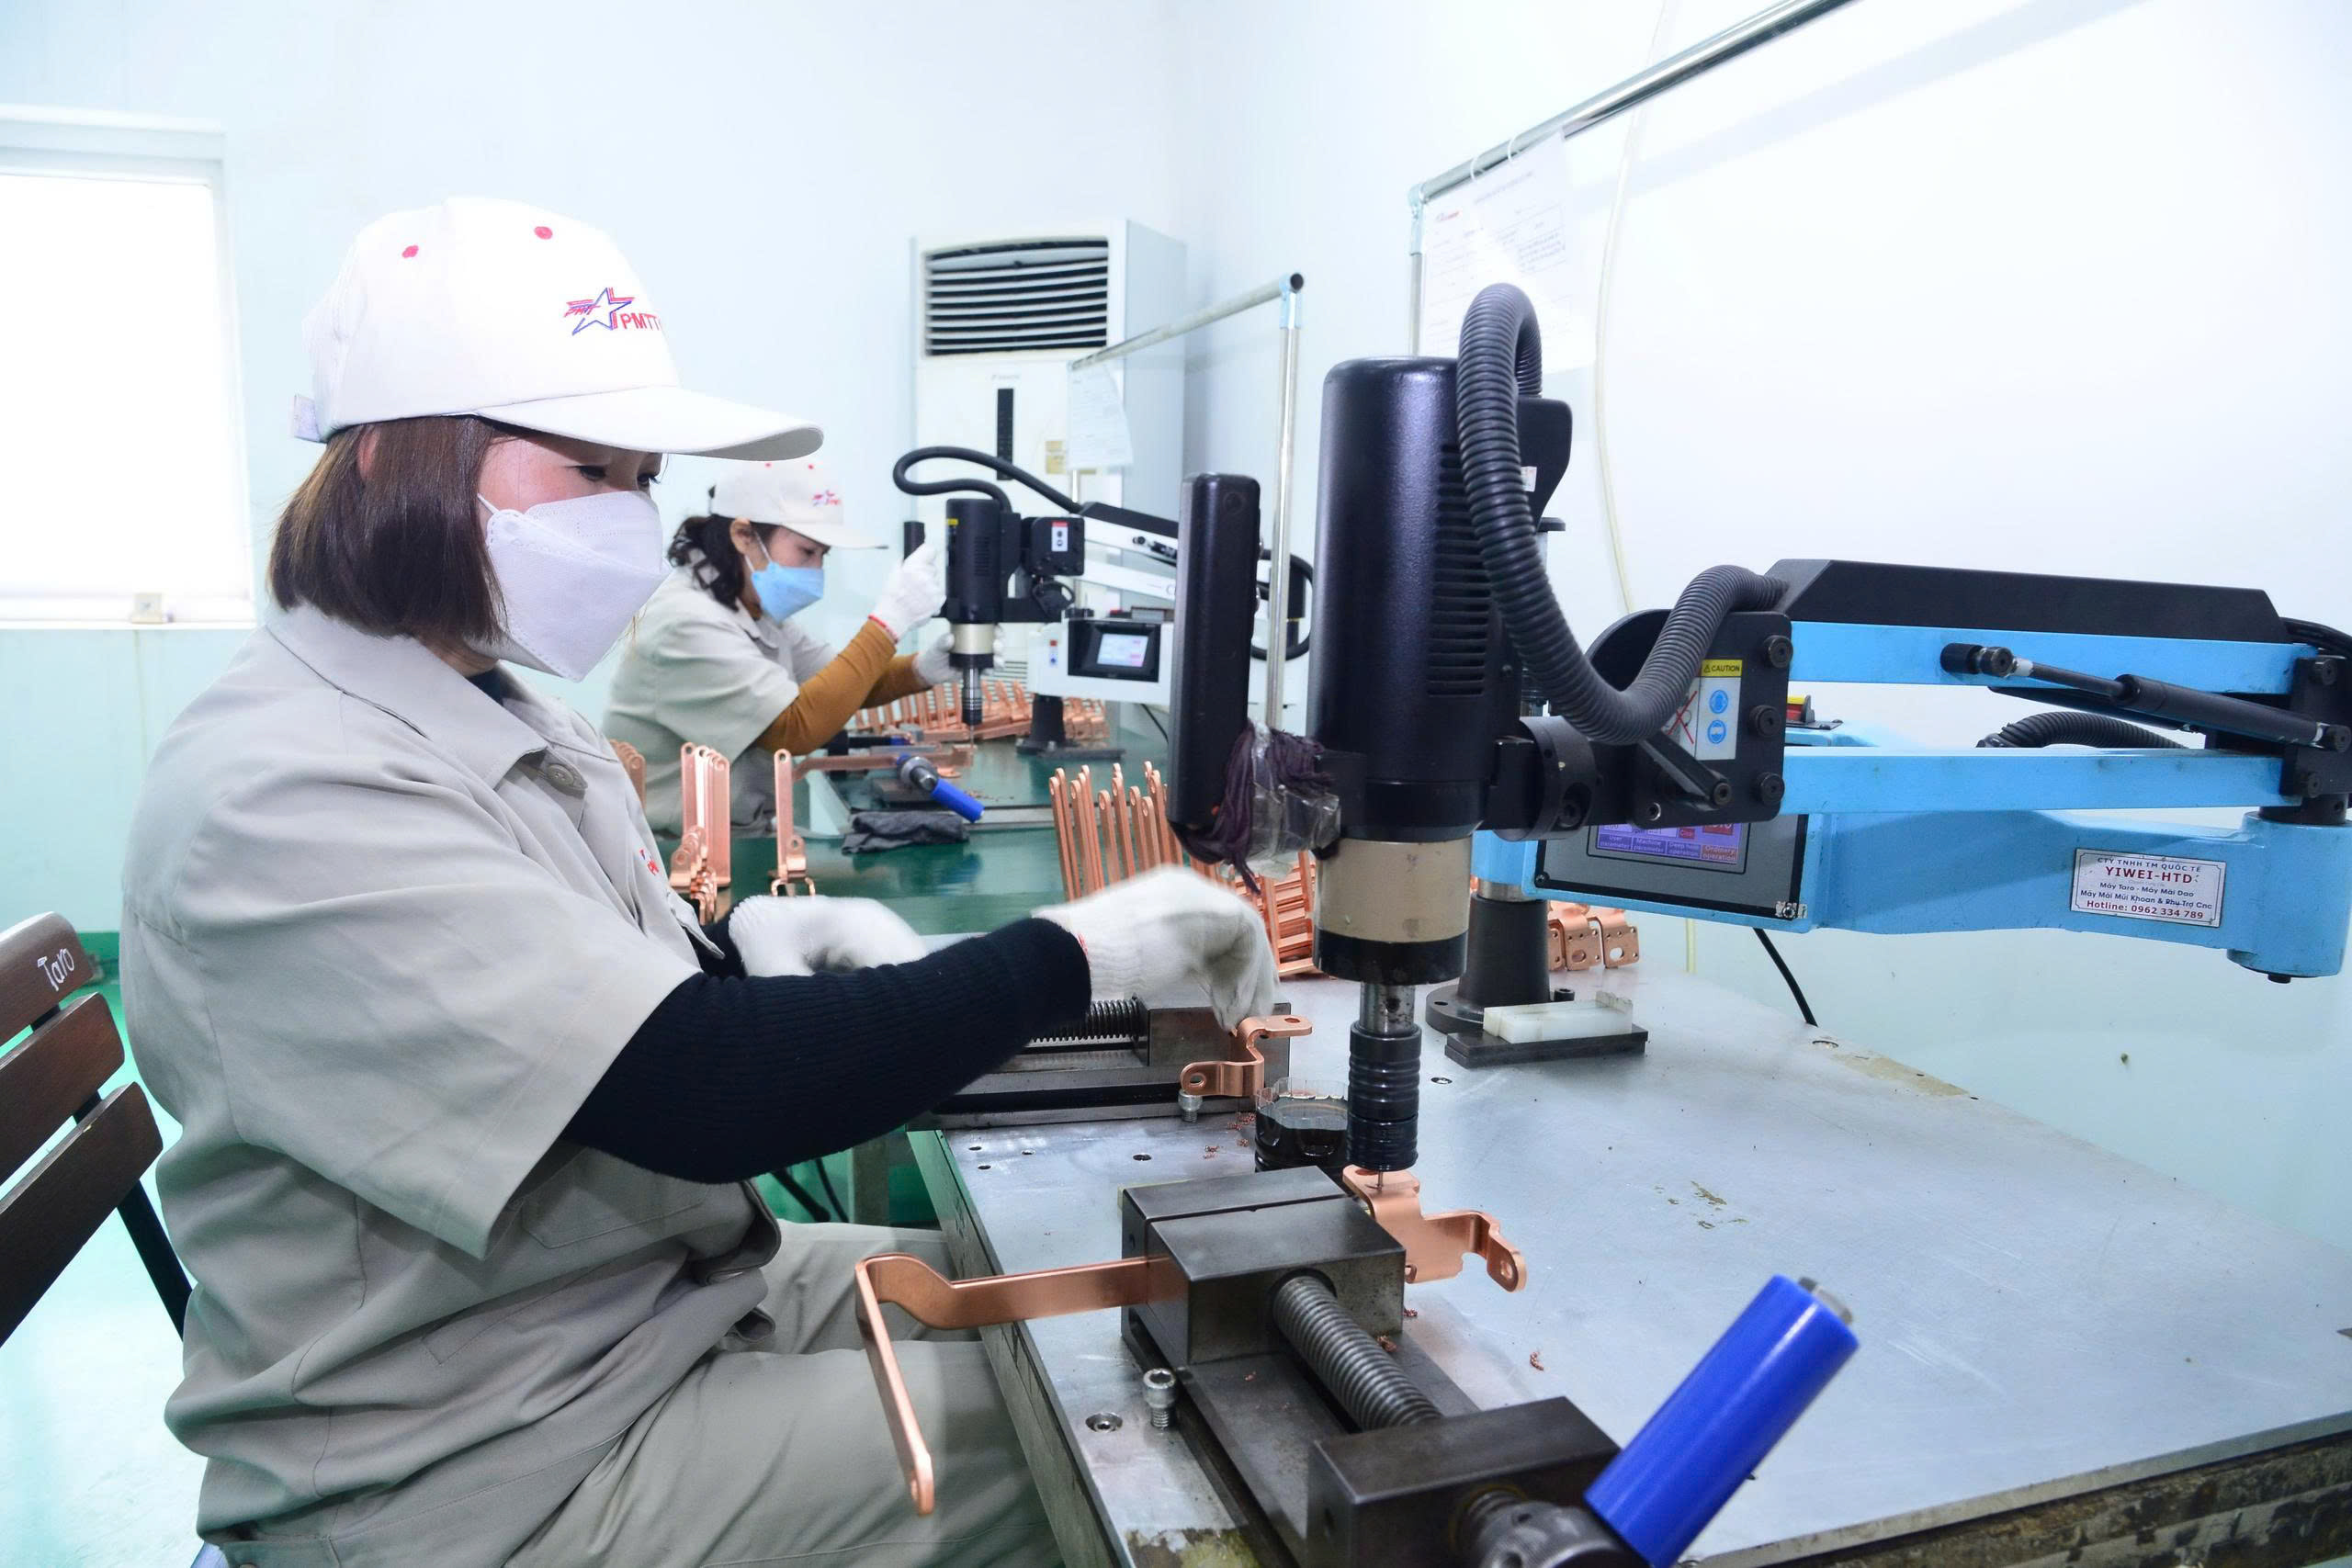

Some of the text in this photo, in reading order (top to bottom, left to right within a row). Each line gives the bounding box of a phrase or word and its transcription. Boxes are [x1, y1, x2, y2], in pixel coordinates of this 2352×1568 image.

[619, 312, 662, 331] PMTT
[1712, 664, 1740, 672] CAUTION
[1702, 852, 1736, 861] operation
[1705, 845, 1736, 854] Ordinary
[2106, 866, 2192, 883] YIWEI-HTD
[2099, 882, 2117, 890] Máy
[2142, 886, 2158, 895] Máy
[2131, 895, 2155, 904] Khoan
[2196, 901, 2212, 909] Cnc
[2086, 900, 2203, 919] Hotline: 0962 334 789
[37, 948, 74, 992] Taro
